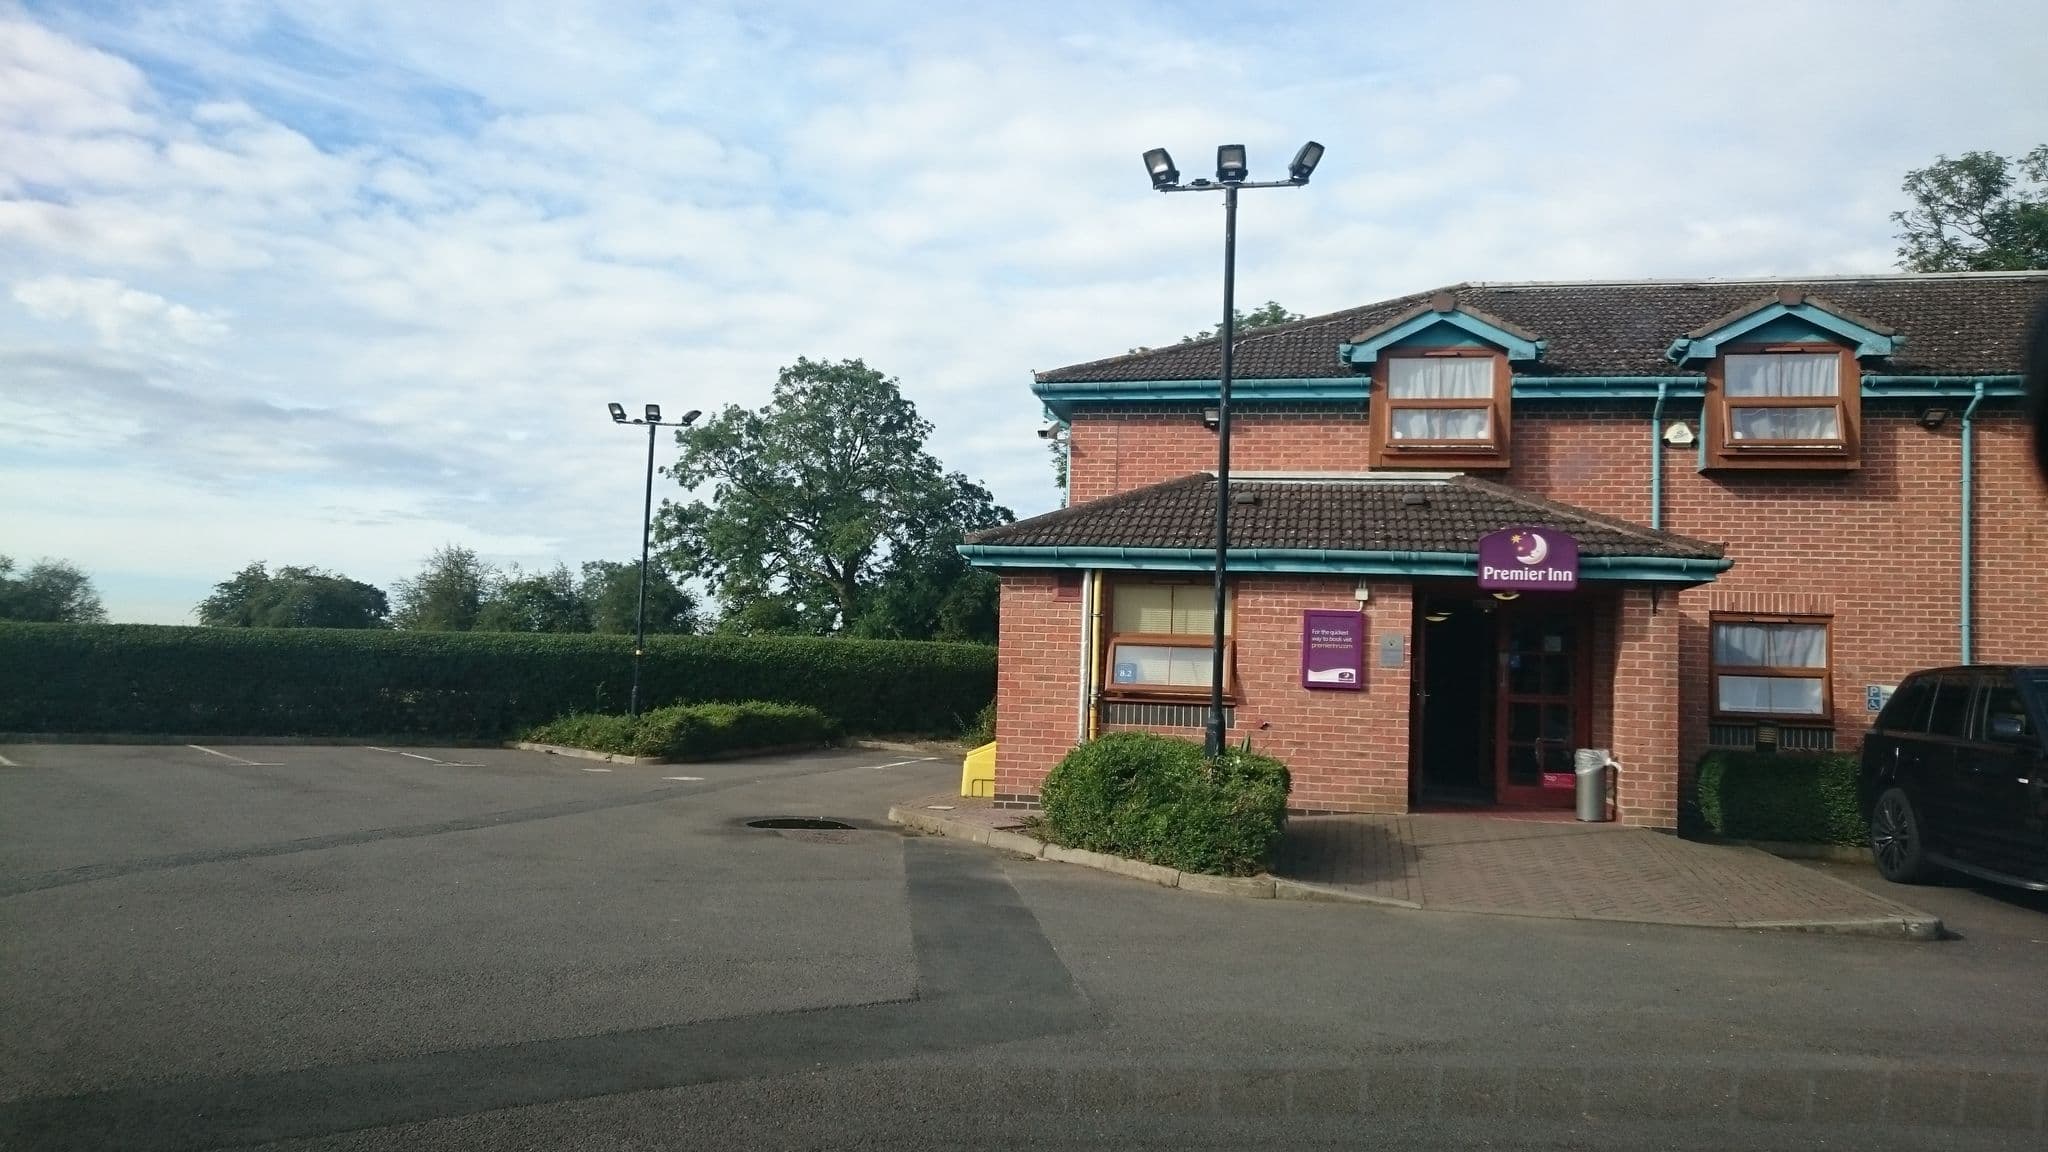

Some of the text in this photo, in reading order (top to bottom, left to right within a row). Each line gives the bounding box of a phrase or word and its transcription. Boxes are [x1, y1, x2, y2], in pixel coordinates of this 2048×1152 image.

[1483, 566, 1573, 582] Premier Inn
[1870, 686, 1879, 697] P
